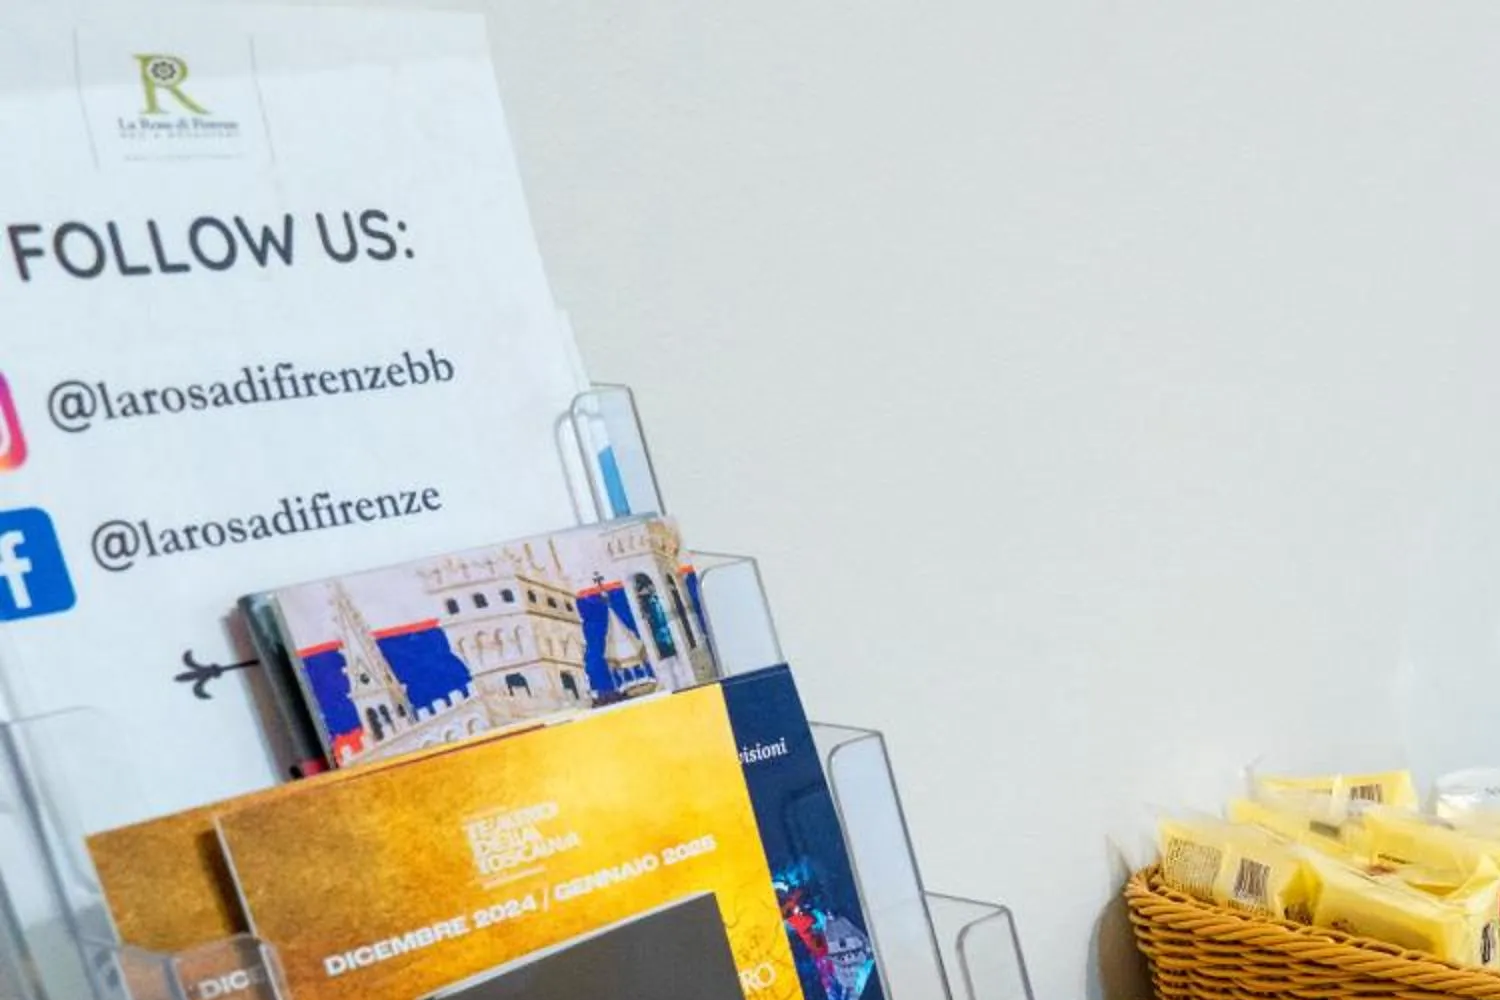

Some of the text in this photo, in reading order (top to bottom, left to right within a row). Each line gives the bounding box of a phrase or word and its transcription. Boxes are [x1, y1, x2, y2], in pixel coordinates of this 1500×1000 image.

[7, 209, 415, 282] FOLLOW US:
[47, 348, 455, 433] @larosadifirenzebb
[91, 485, 444, 572] @larosadifirenze
[323, 914, 471, 977] DICEMBRE
[473, 893, 537, 929] 2024
[554, 854, 660, 901] GENNAIO
[662, 833, 718, 867] 2025
